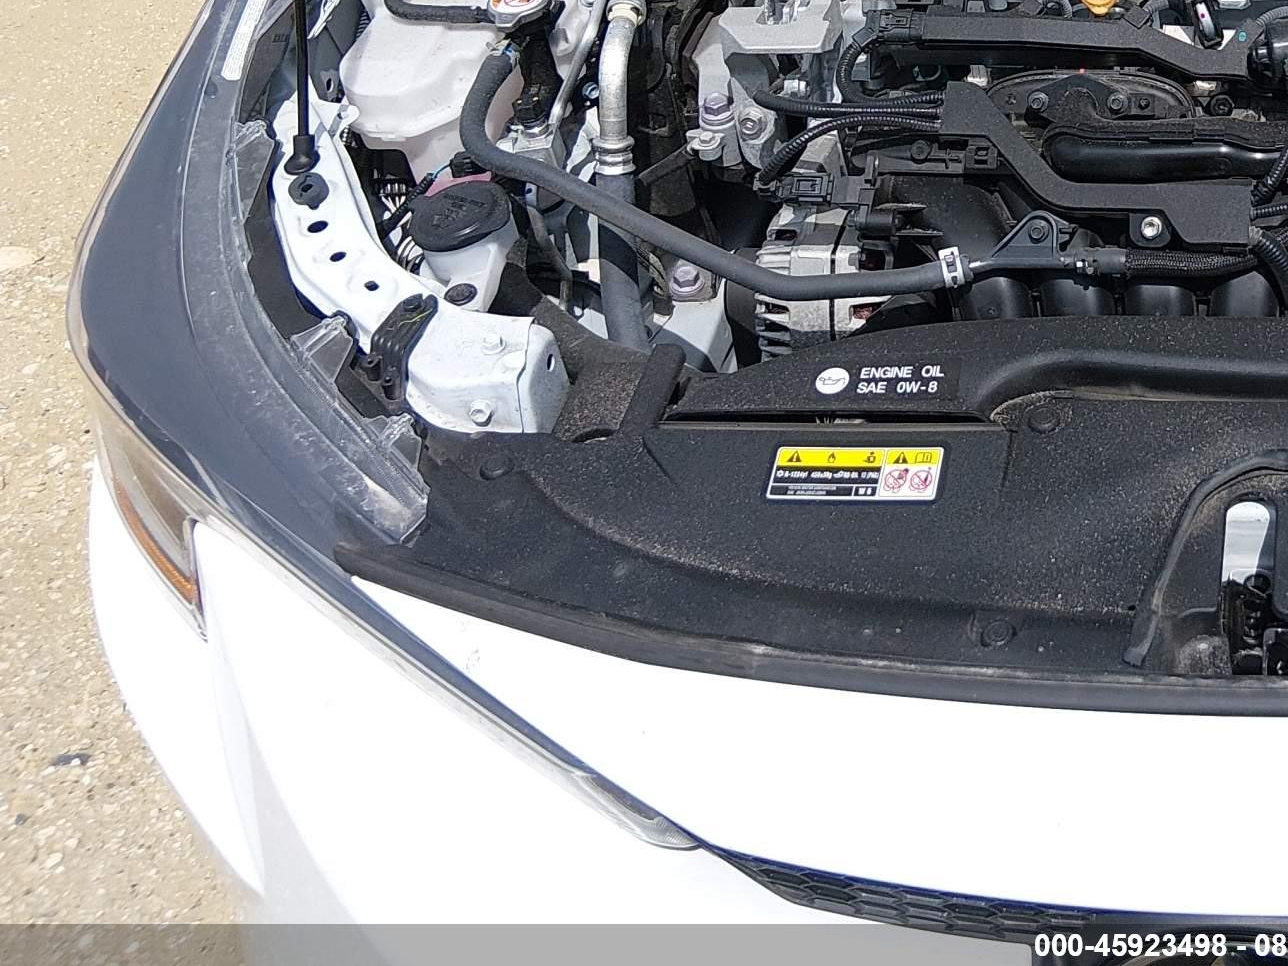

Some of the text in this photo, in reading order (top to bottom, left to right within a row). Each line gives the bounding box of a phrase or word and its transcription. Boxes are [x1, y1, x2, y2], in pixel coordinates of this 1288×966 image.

[860, 365, 945, 379] ENGINE OIL
[856, 380, 939, 394] SAE 0W-8
